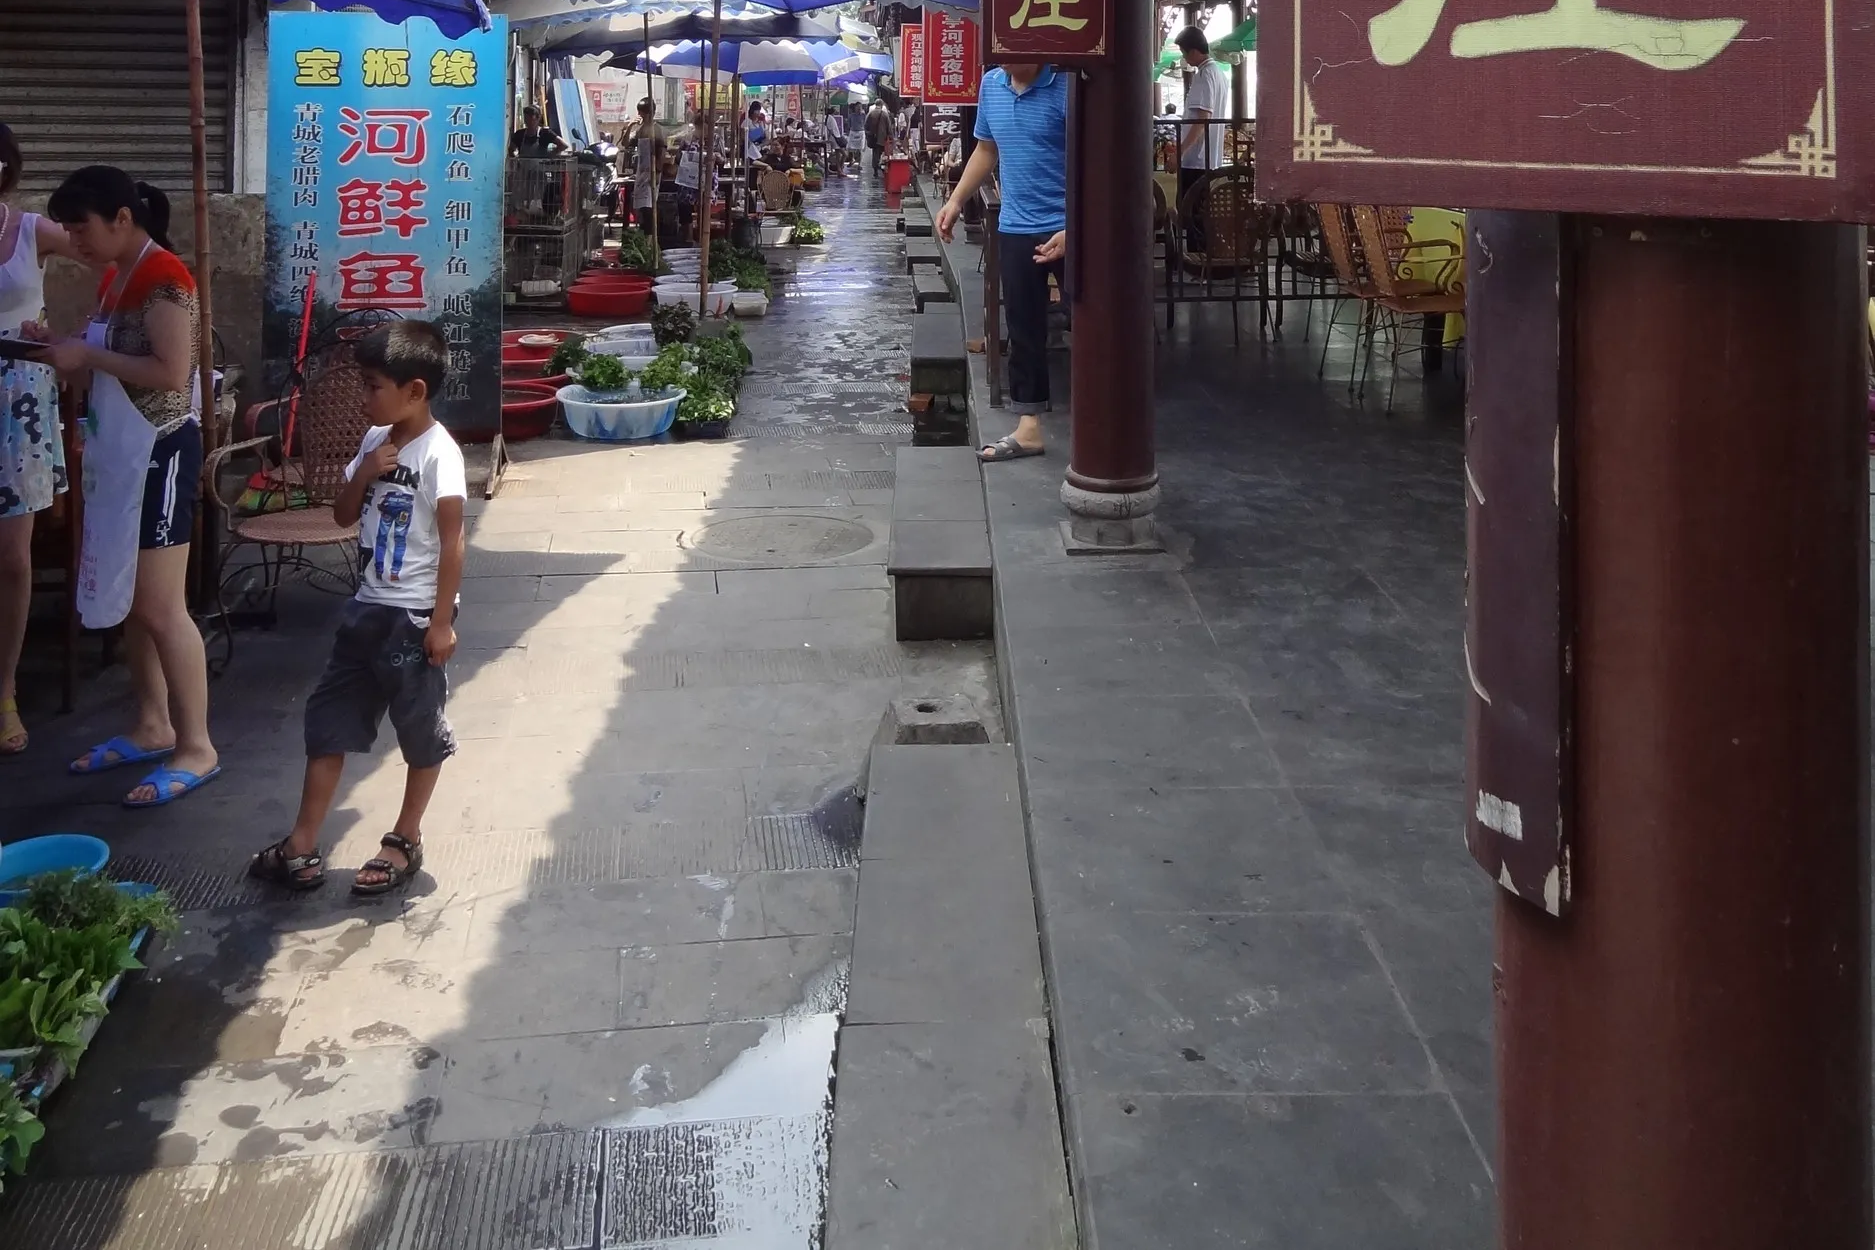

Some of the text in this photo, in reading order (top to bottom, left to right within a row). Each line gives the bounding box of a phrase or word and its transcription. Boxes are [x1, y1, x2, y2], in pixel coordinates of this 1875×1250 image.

[294, 47, 478, 88] 宝瓶缘
[941, 11, 964, 88] 亭河鲜夜啤
[291, 102, 324, 208] 青城老腊肉
[445, 103, 476, 183] 石爬鱼
[336, 106, 430, 338] 河鲜鱼
[444, 200, 473, 279] 细甲鱼
[290, 220, 321, 306] 青城四绝
